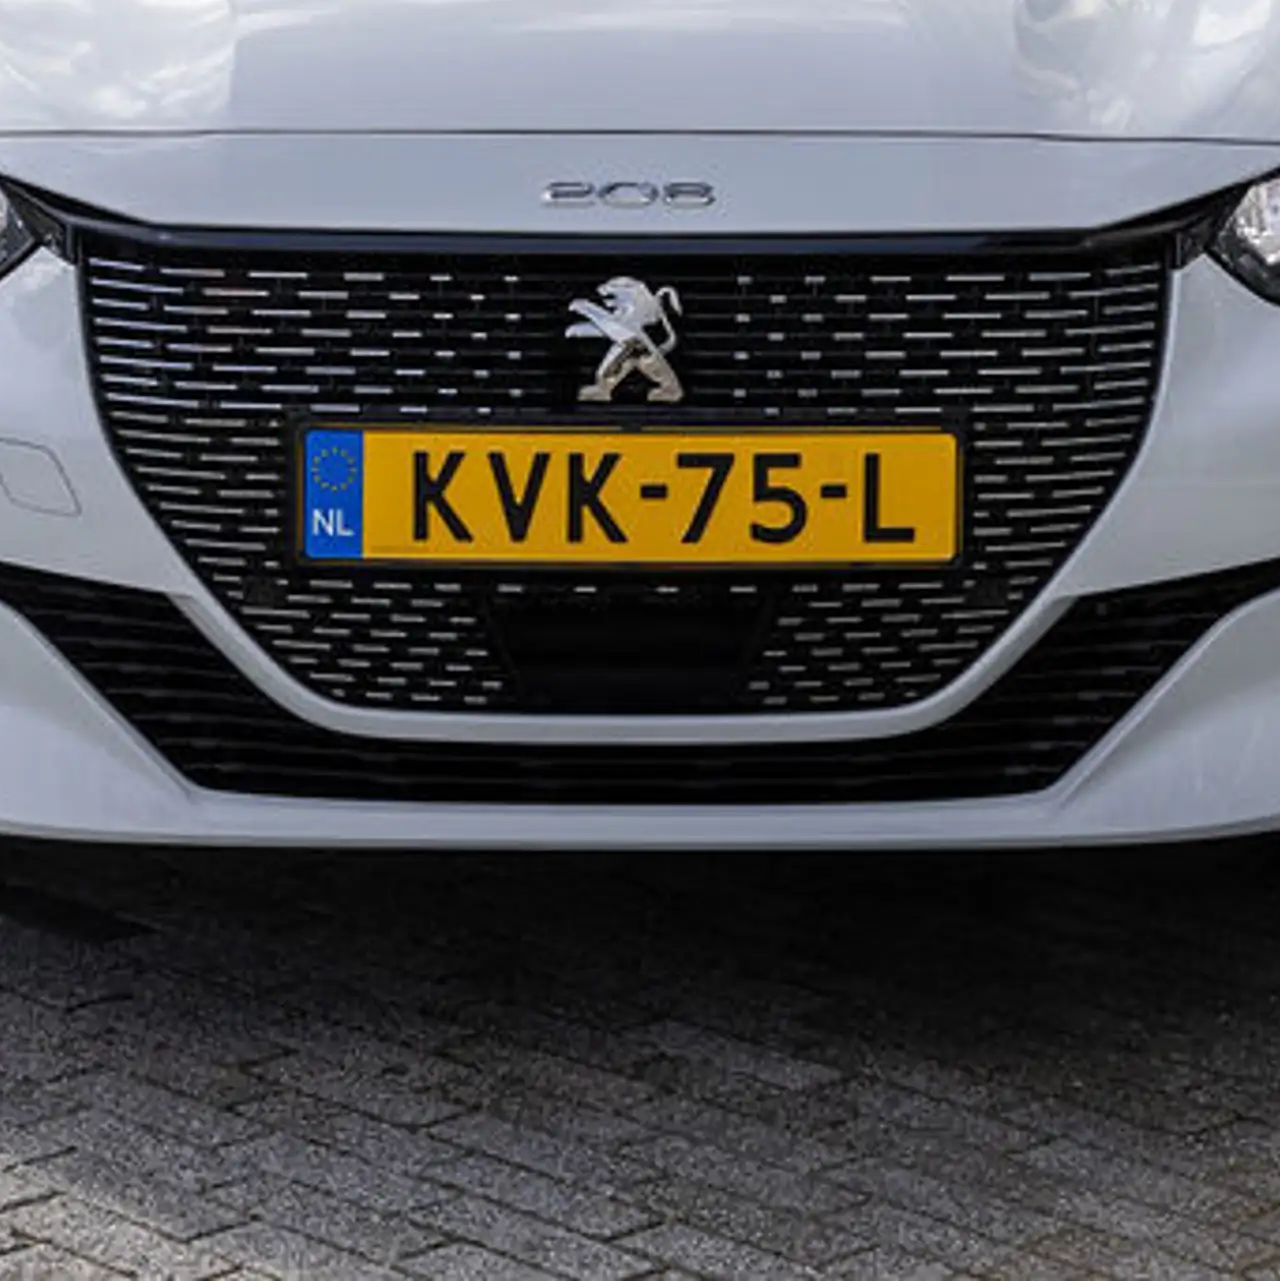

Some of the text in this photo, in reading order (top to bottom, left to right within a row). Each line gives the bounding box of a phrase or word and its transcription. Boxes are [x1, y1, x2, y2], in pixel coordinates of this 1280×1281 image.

[541, 181, 716, 208] 208
[412, 450, 916, 544] KVK-75-L
[312, 508, 355, 537] NL
